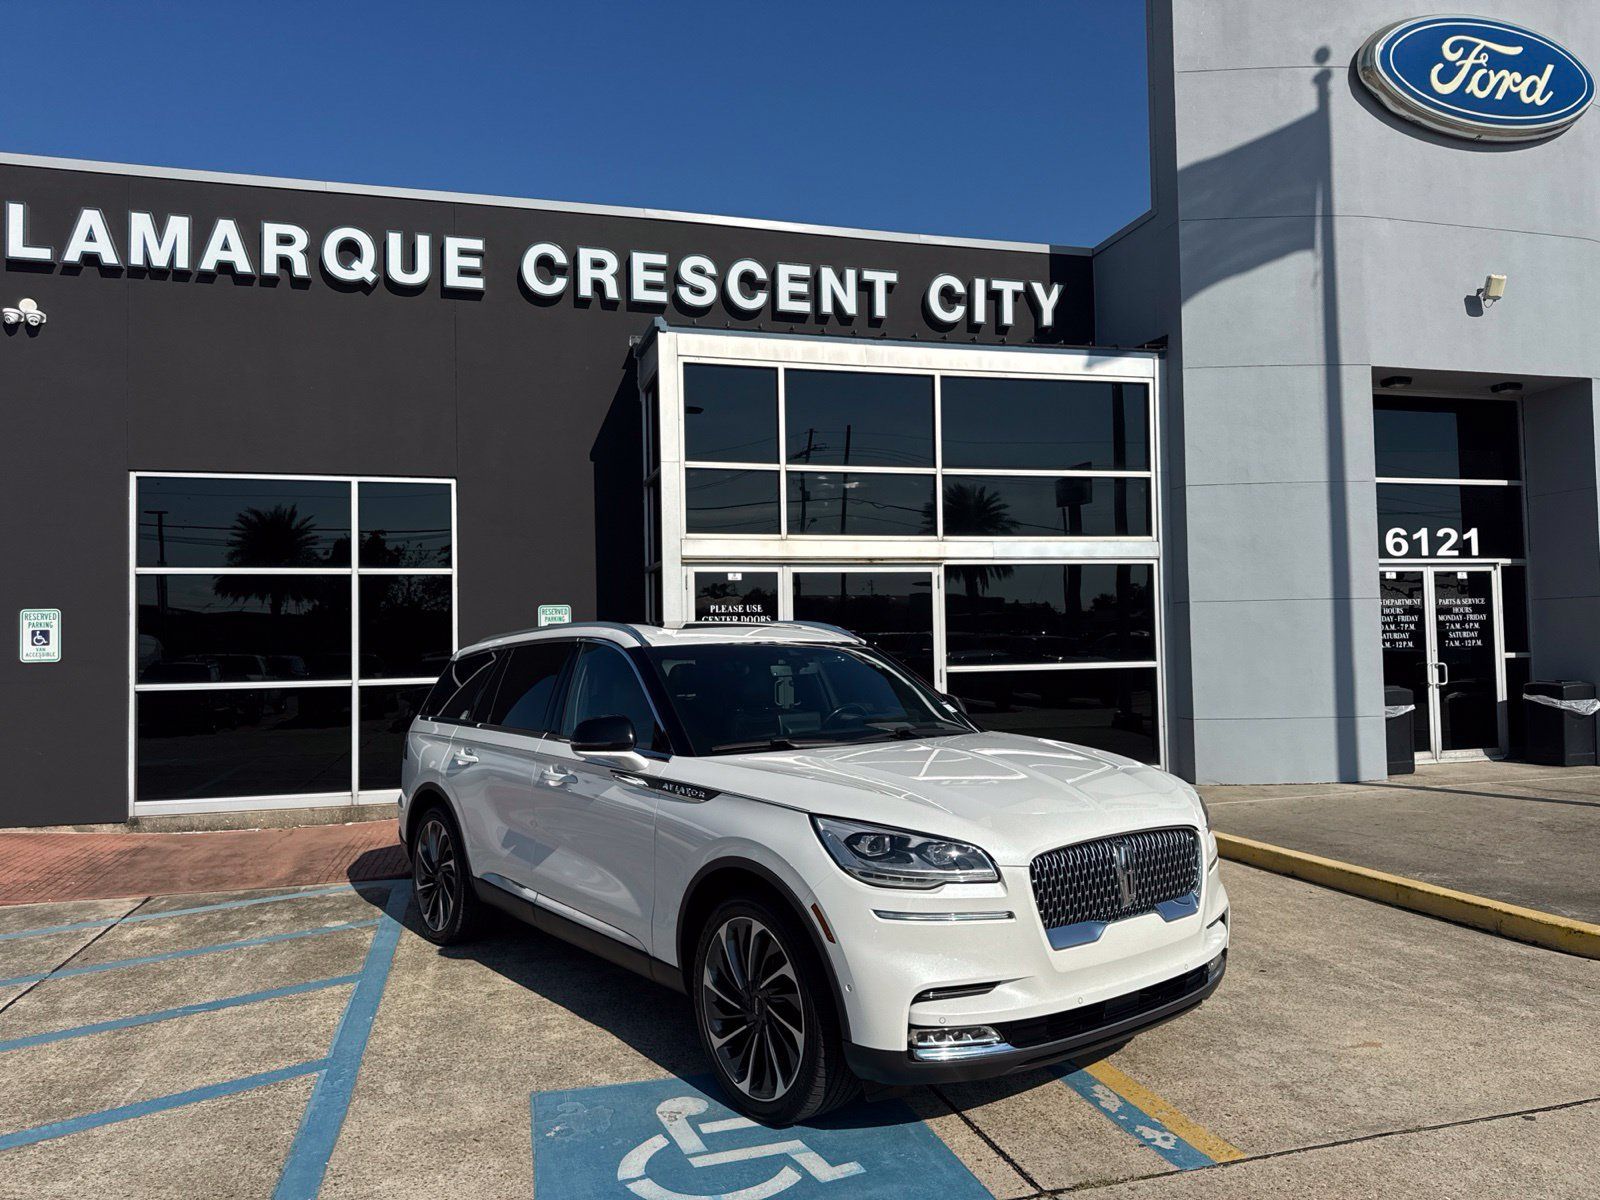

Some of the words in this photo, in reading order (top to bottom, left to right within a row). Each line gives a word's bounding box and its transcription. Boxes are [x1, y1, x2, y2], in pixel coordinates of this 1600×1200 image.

[1430, 35, 1555, 107] Ford
[6, 202, 486, 291] LAMARQUE
[520, 242, 899, 318] CRESCENT
[927, 273, 1066, 328] CITY
[1385, 527, 1479, 557] 6121
[1382, 598, 1421, 606] DEPARTMENT
[1461, 597, 1486, 605] SERVICE
[710, 604, 744, 613] PLEASE
[746, 604, 763, 613] USE
[1383, 607, 1404, 615] HOURS
[1452, 606, 1473, 614] HOURS
[1466, 613, 1487, 621] FRIDAY
[1448, 631, 1479, 639] SATURDAY
[662, 782, 706, 798] AVIATOR
